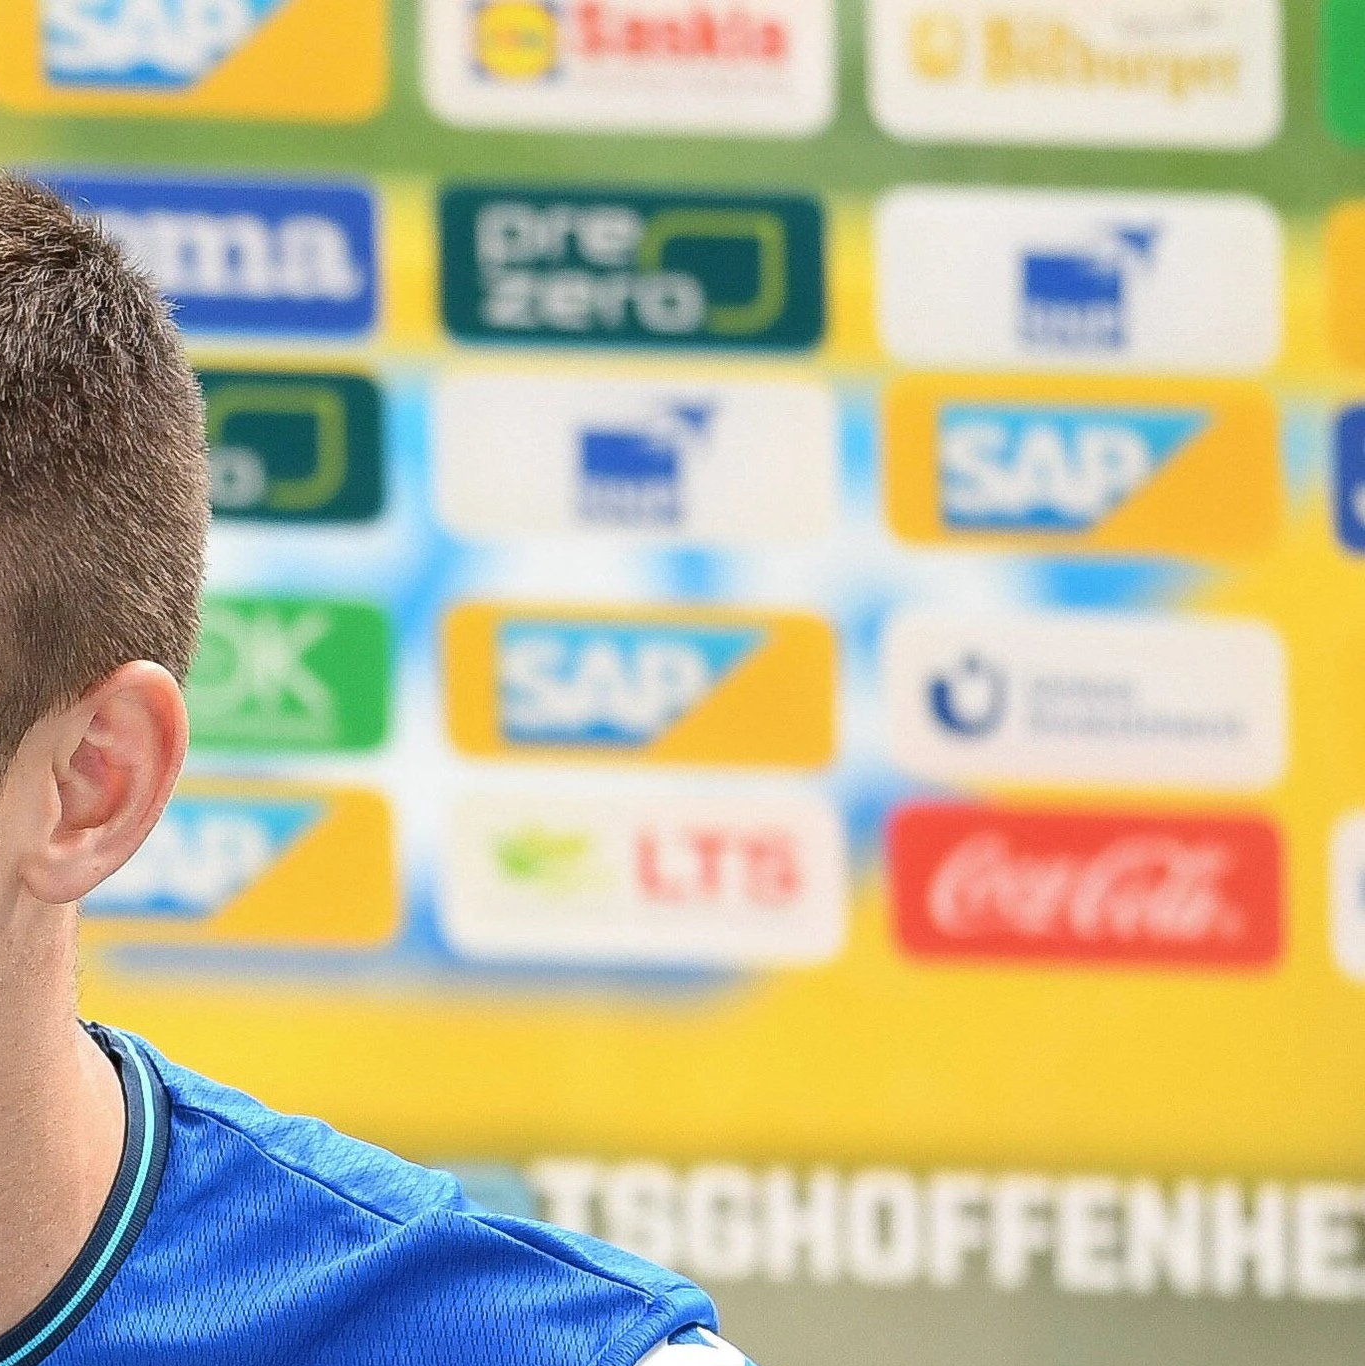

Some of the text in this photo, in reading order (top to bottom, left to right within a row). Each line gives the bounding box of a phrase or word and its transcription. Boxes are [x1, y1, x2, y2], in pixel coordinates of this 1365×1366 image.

[475, 200, 644, 275] pre
[483, 270, 707, 335] zero
[943, 421, 1154, 518] SAP
[504, 637, 710, 731] SAP
[103, 815, 269, 902] AP
